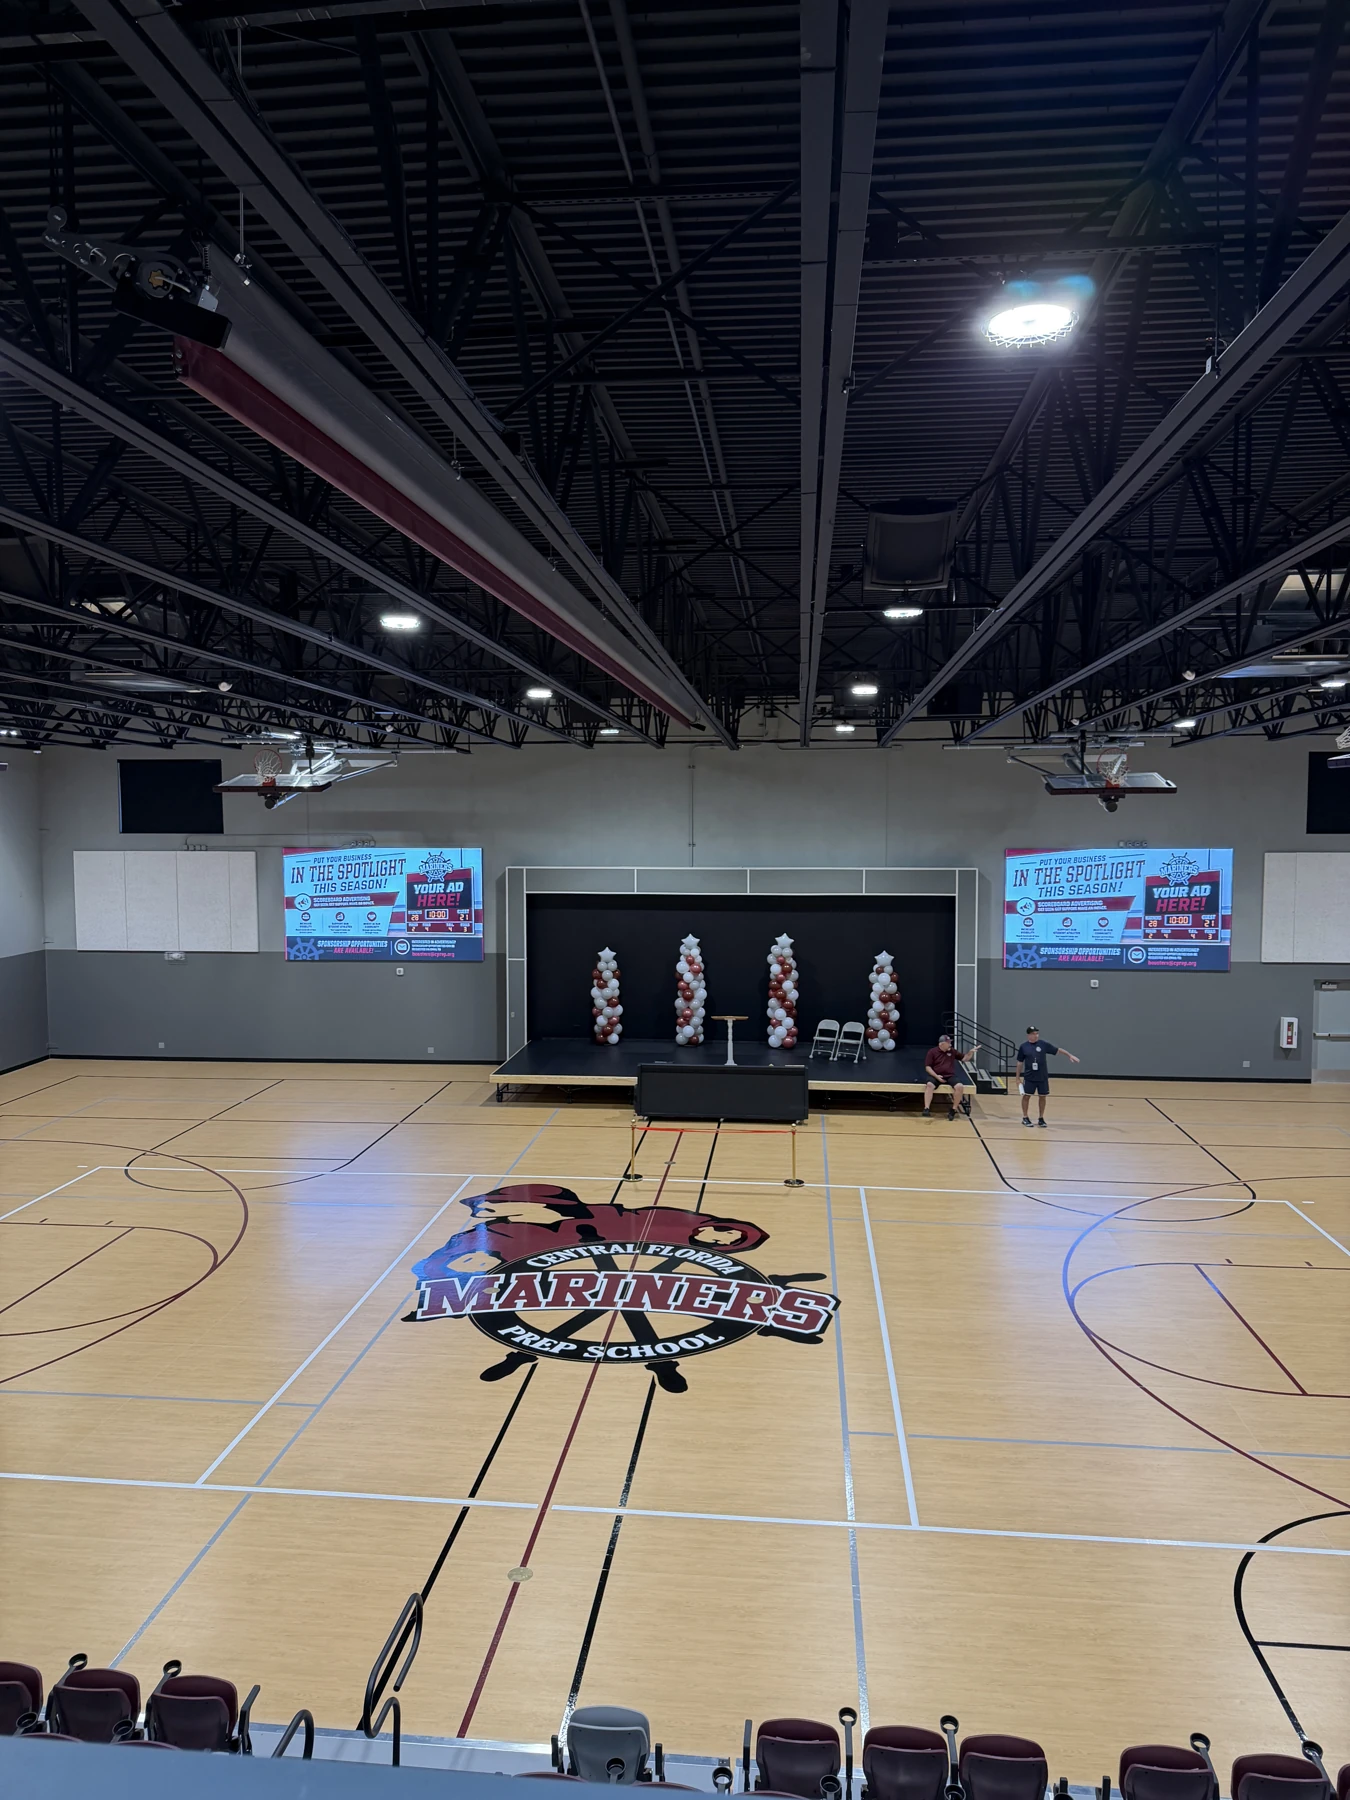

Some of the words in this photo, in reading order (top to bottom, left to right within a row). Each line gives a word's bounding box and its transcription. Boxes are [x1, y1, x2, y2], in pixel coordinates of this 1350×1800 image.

[344, 854, 372, 862] BUSINESS
[1054, 857, 1072, 865] YOUR
[1073, 855, 1107, 864] BUSINESS
[290, 866, 304, 884] IN
[309, 864, 334, 882] THE
[338, 858, 406, 880] SPOTLIGHT
[419, 862, 454, 875] MARINERS
[1012, 868, 1029, 888] IN
[1034, 866, 1062, 886] THE
[1066, 859, 1146, 884] SPOTLIGHT
[1159, 864, 1199, 878] MARINERS
[313, 882, 336, 894] THIS
[340, 878, 388, 892] SEASON!
[414, 883, 444, 894] YOUR
[446, 882, 464, 892] AD
[1038, 886, 1065, 898] THIS
[1068, 881, 1123, 896] SEASON!
[1152, 886, 1189, 898] YOUR
[1190, 885, 1212, 896] AD
[416, 893, 460, 907] HERE!
[1155, 897, 1206, 912] HERE!
[526, 1243, 640, 1268] CENTRAL
[646, 1244, 744, 1276] FLORIDA
[417, 1272, 839, 1334] MARINERS
[497, 1324, 578, 1355] PREP
[582, 1331, 725, 1360] SCHOOL
